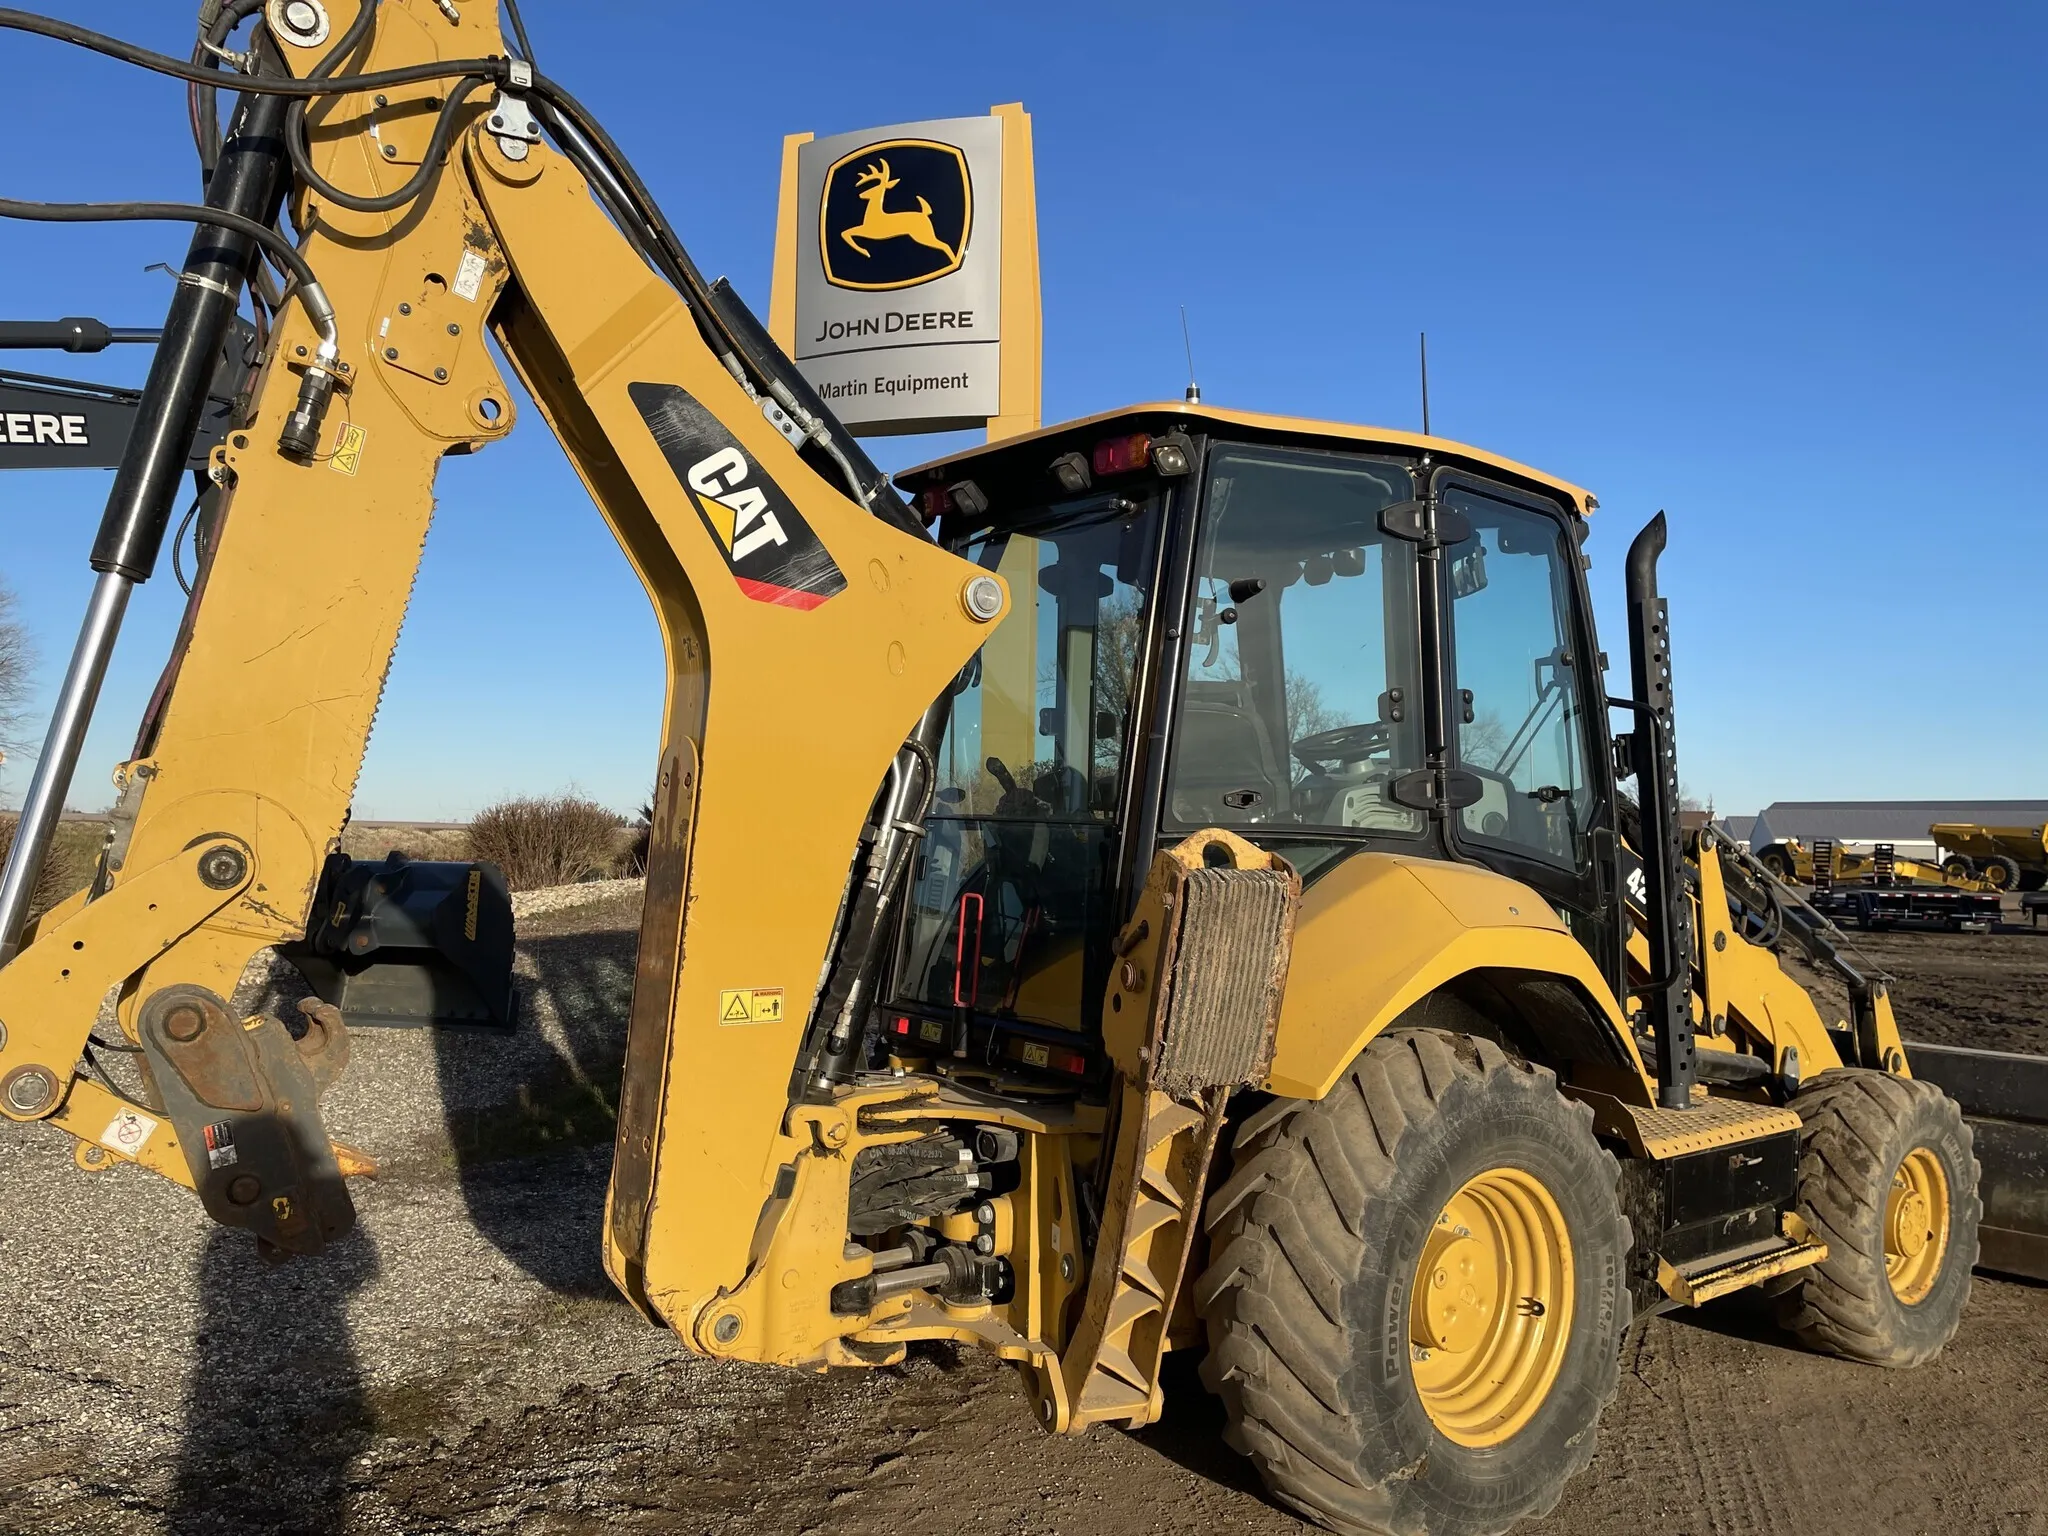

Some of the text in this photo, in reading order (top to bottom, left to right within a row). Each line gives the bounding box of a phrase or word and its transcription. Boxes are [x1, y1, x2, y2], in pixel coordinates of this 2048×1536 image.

[815, 311, 974, 342] JOHN DEERE
[818, 372, 969, 400] Martin Equipment
[688, 447, 788, 562] CAT
[1385, 1268, 1404, 1379] Power
